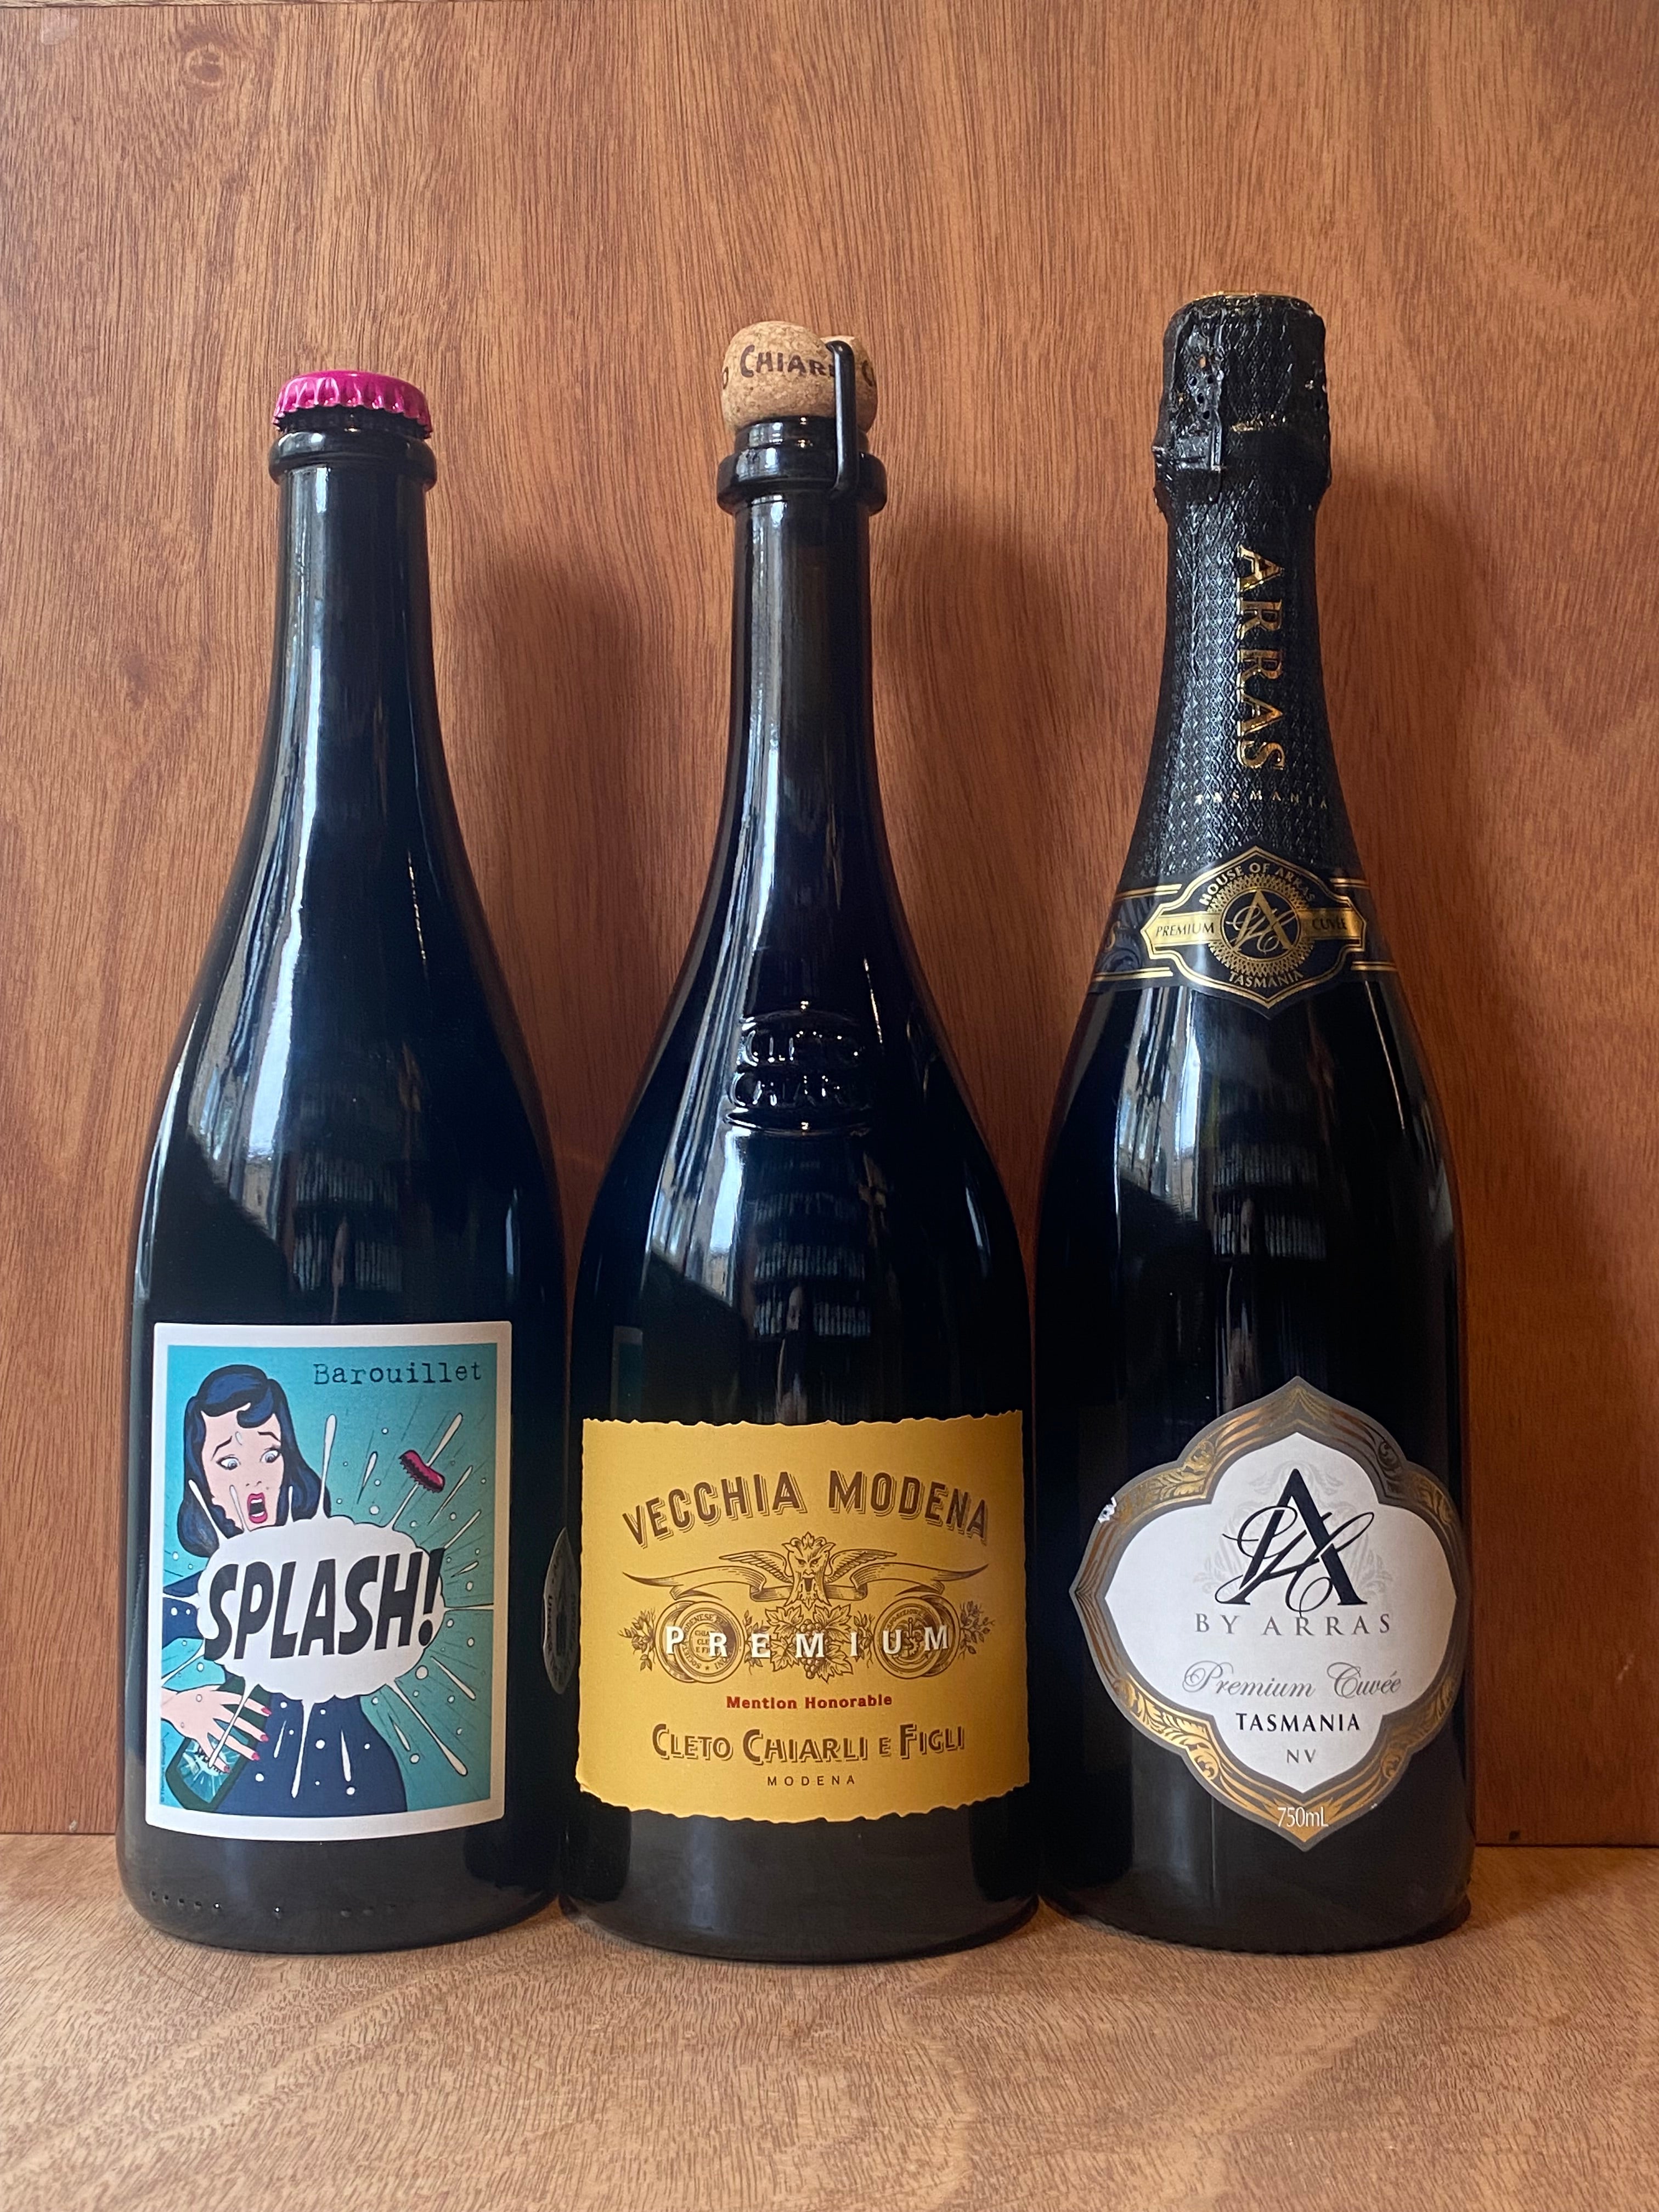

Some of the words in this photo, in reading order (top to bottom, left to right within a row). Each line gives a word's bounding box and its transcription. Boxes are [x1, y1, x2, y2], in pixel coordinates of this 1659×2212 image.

[741, 344, 835, 377] CHIAR
[1237, 543, 1285, 770] ARRAS
[1194, 789, 1328, 809] TASMANIA
[1199, 865, 1245, 906] HOUSE
[1249, 862, 1271, 873] OF
[1274, 865, 1316, 902] ARRAS
[1155, 922, 1215, 938] PREMIUM
[1229, 970, 1304, 988] TASMANIA
[313, 1362, 481, 1385] Barouillet
[622, 1471, 807, 1549] VECCHIA
[828, 1470, 988, 1544] MODENA
[204, 1547, 445, 1661] SPLASH!
[1195, 1613, 1241, 1635] BY
[1262, 1613, 1391, 1636] ARRAS
[665, 1625, 950, 1659] PREMIUM
[1182, 1660, 1316, 1698] Premium
[1326, 1661, 1402, 1699] Cuvée
[726, 1695, 798, 1709] Mention
[804, 1694, 893, 1709] Honorable
[1235, 1712, 1361, 1732] TASMANIA
[652, 1723, 733, 1762] CLETO
[743, 1728, 868, 1765] CHIARLI
[879, 1736, 892, 1757] E
[899, 1723, 965, 1759] FIGLI
[1286, 1748, 1317, 1764] NV
[767, 1775, 855, 1786] MODENA
[1277, 1806, 1329, 1827] 750mL
